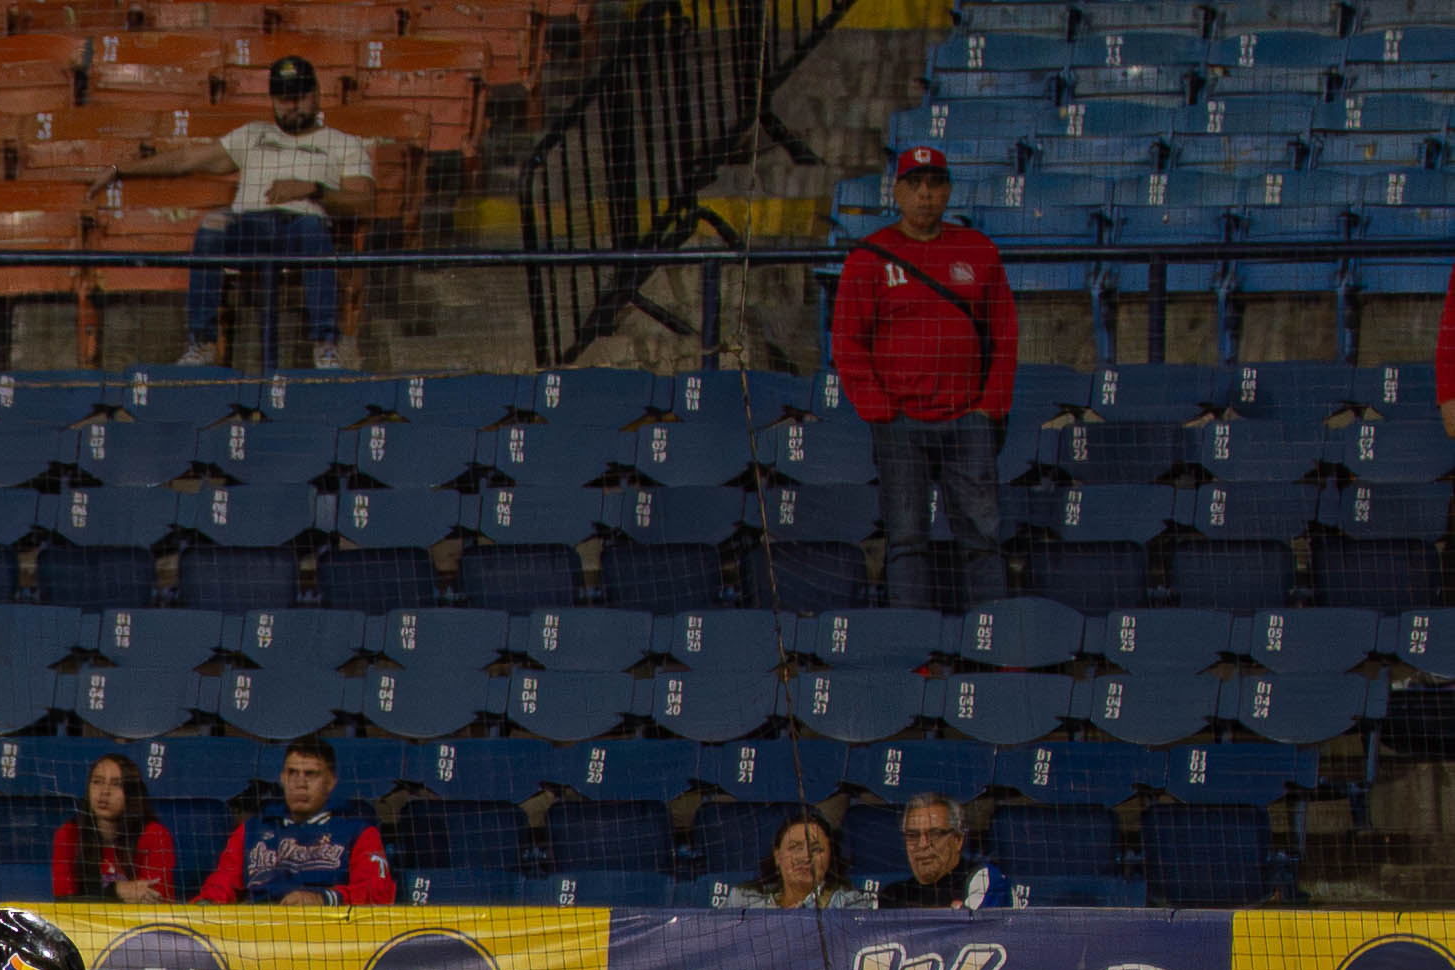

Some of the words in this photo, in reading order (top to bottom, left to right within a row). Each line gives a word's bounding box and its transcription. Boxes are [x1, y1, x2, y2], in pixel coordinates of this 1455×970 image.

[543, 627, 557, 638] 05
[687, 629, 701, 640] 05
[833, 630, 846, 641] 05
[977, 627, 991, 638] 05
[1121, 628, 1134, 639] 05
[1268, 628, 1282, 638] 05
[544, 639, 557, 650] 19
[687, 641, 701, 651] 20
[832, 642, 845, 652] 21
[978, 639, 991, 650] 22
[1121, 640, 1134, 651] 23
[1267, 639, 1281, 651] 24
[379, 689, 393, 699] 04
[522, 691, 536, 701] 04
[668, 693, 681, 703] 04
[815, 691, 828, 702] 04
[381, 700, 392, 711] 18
[959, 695, 973, 706] 04
[1107, 696, 1121, 706] 04
[1255, 695, 1269, 706] 04
[523, 702, 536, 713] 19
[666, 704, 680, 715] 20
[813, 703, 826, 714] 21
[959, 707, 973, 718] 22
[1105, 707, 1119, 718] 23
[1254, 707, 1268, 718] 24
[439, 758, 453, 769] 03
[589, 761, 604, 771] 03
[740, 760, 754, 771] 03
[886, 762, 900, 773] 03
[1035, 762, 1049, 773] 03
[1190, 761, 1206, 772] 03
[440, 770, 452, 781] 19
[587, 772, 602, 783] 20
[739, 772, 752, 783] 21
[885, 774, 899, 786] 22
[1034, 774, 1048, 785] 23
[1190, 773, 1205, 783] 24
[413, 890, 428, 901] 02
[560, 893, 574, 903] 02
